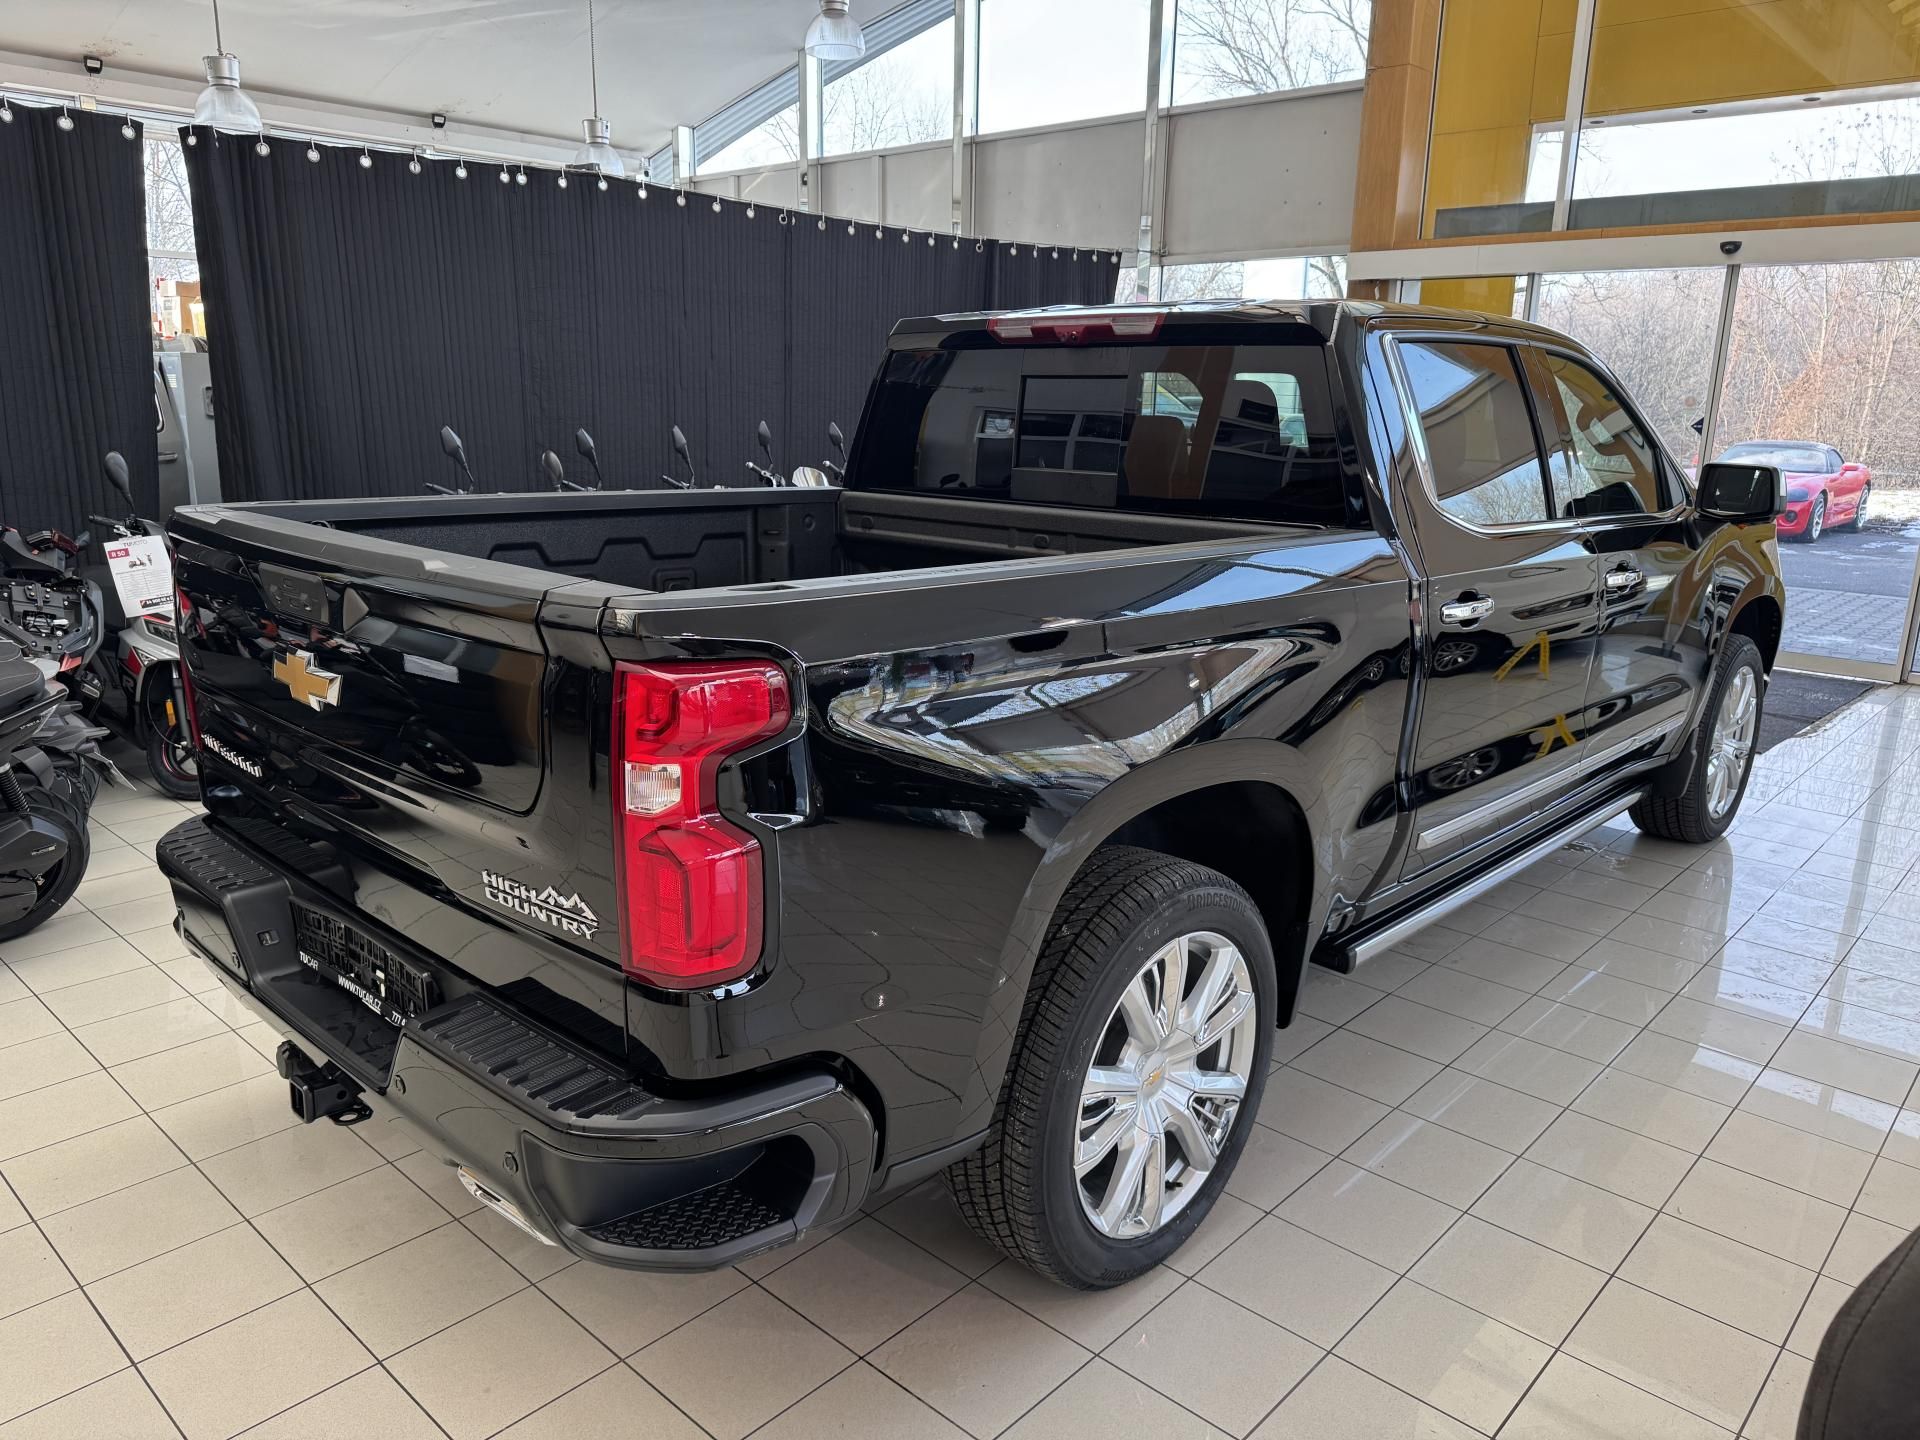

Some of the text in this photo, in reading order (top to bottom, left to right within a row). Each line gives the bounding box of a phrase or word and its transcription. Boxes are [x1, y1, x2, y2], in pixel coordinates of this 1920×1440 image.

[481, 869, 537, 903] HIGH
[484, 886, 599, 940] COUNTRY
[1186, 892, 1248, 917] BRIDGESTONE
[299, 951, 319, 972] TUCAR
[337, 974, 382, 1012] WWW.TUCAR.CZ
